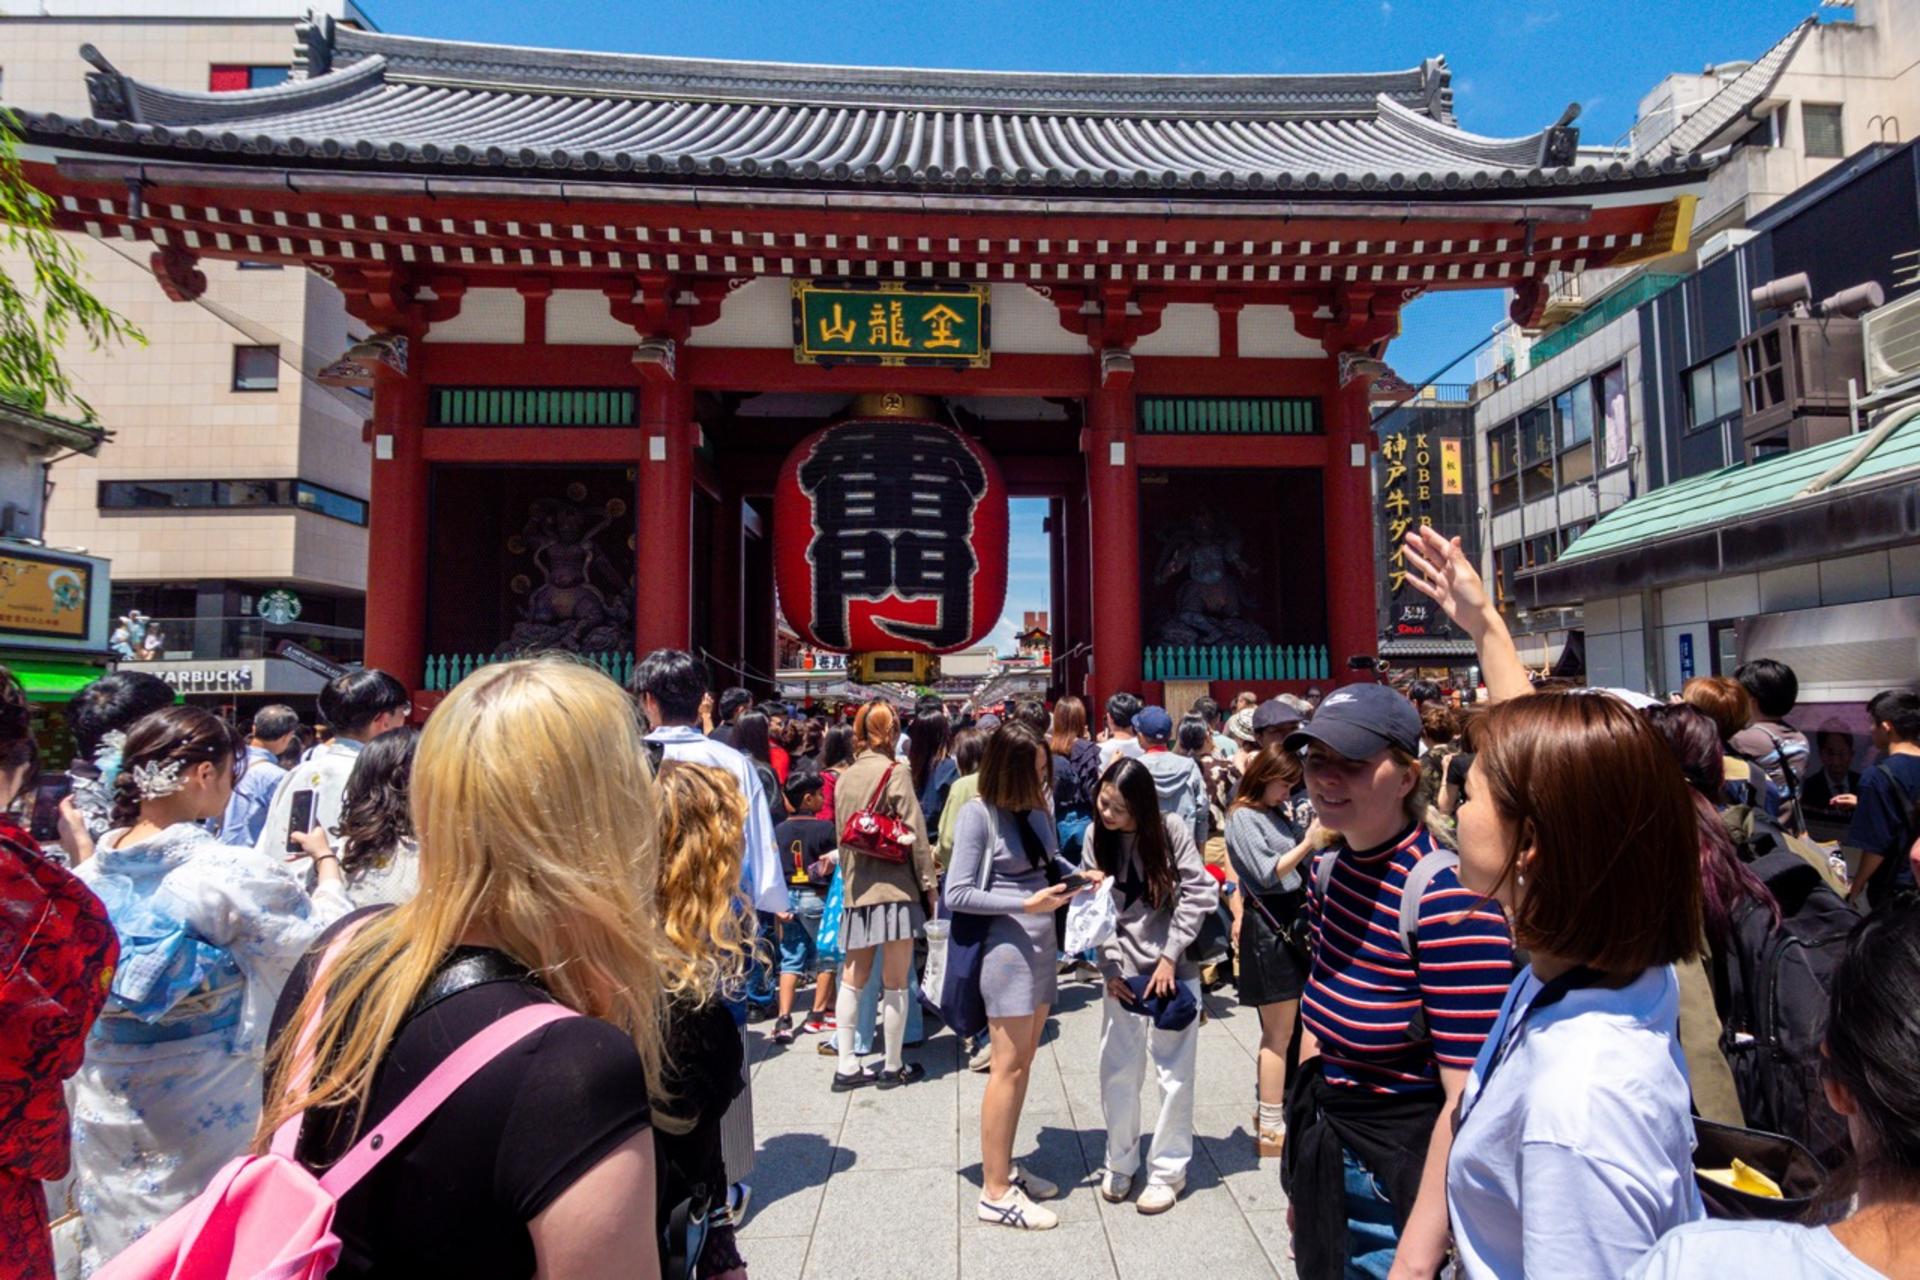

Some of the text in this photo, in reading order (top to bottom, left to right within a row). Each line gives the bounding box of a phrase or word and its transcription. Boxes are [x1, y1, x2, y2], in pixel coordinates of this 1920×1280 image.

[1382, 432, 1413, 592] 神戸牛ダイア
[1416, 433, 1431, 500] KOBE
[797, 420, 988, 650] 雷門
[147, 665, 251, 684] TARBUCKS
